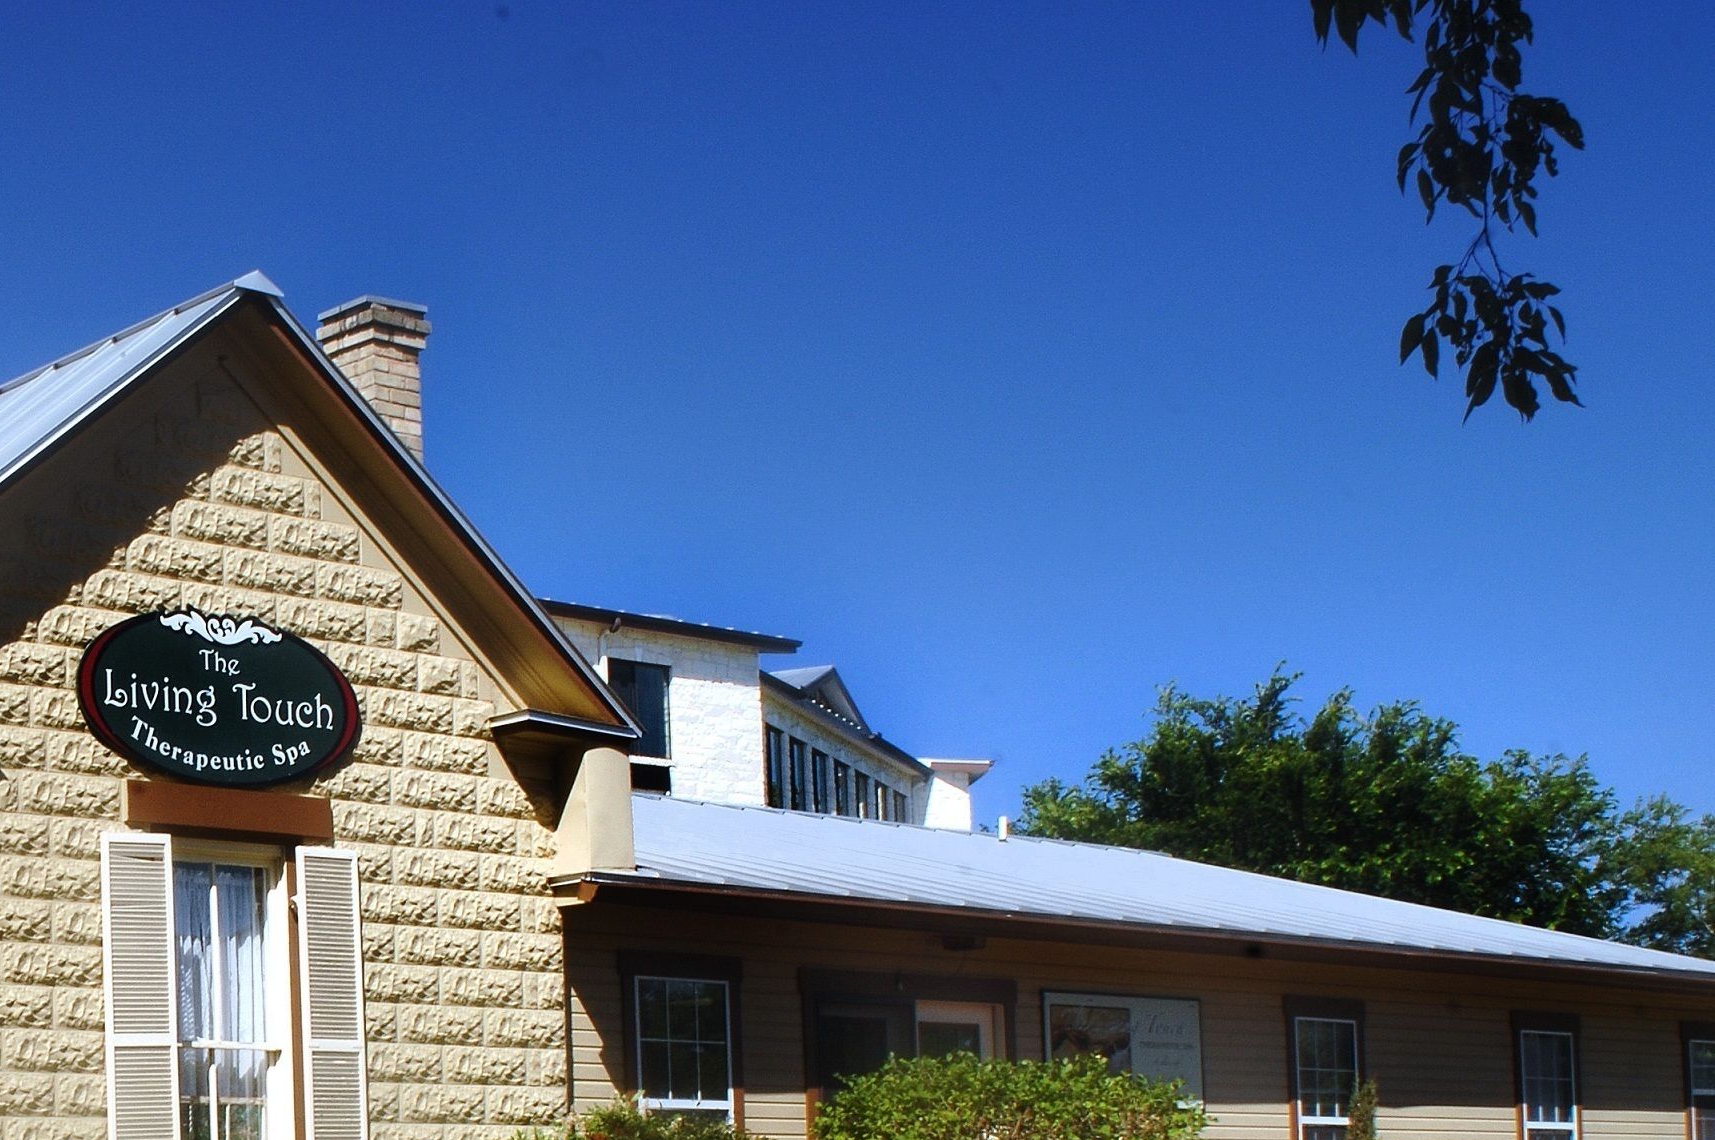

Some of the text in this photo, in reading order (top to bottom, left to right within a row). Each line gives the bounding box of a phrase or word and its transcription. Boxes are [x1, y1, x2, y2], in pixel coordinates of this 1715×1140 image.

[199, 649, 241, 676] The
[104, 668, 334, 730] Living Touch
[130, 716, 311, 771] Therapeutic Spa
